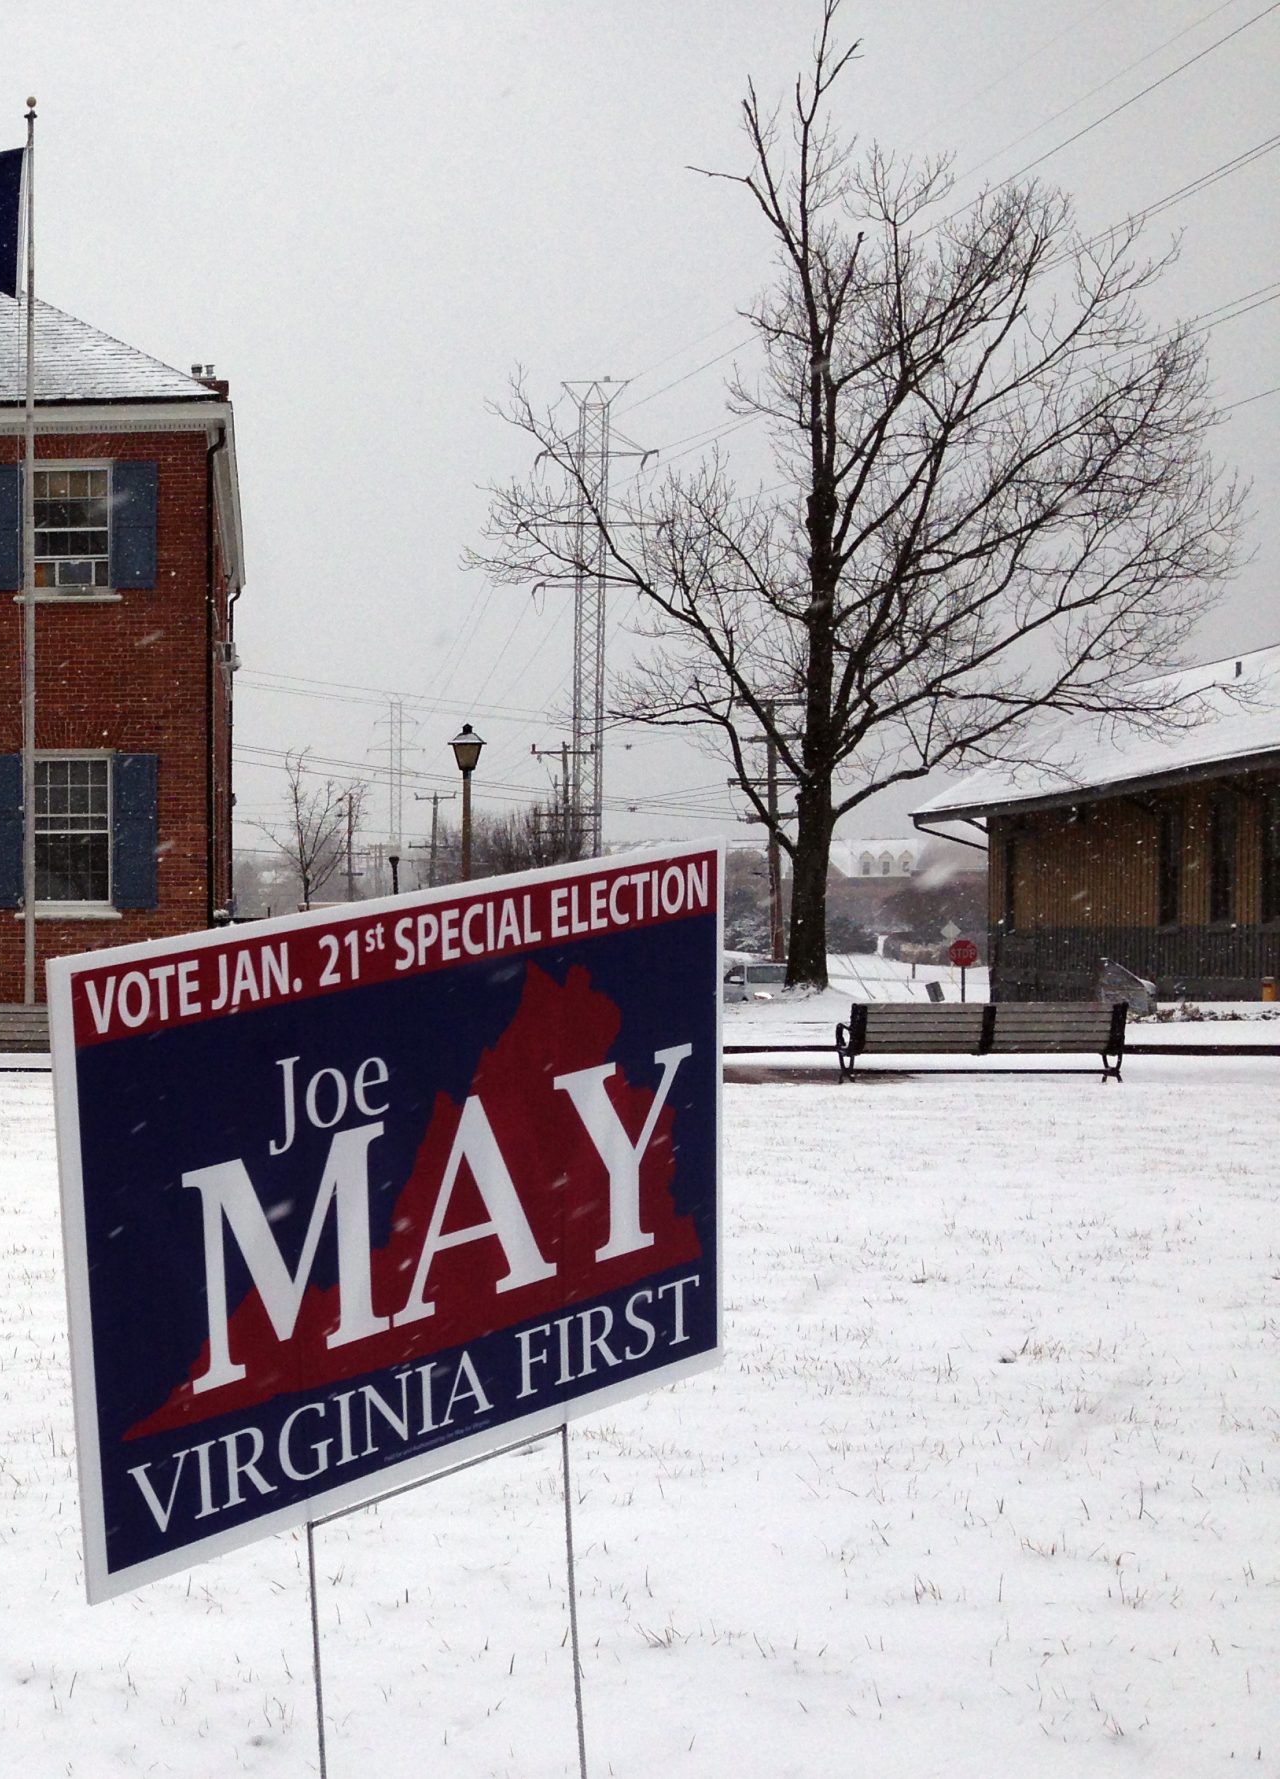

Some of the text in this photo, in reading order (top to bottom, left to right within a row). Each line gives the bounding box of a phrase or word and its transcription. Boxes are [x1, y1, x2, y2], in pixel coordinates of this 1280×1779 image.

[85, 860, 710, 1034] VOTE JAN. 21st SPECIAL ELECTION
[950, 948, 976, 958] STOP
[270, 1056, 391, 1156] Joe
[181, 1043, 693, 1395] MAY
[128, 1275, 700, 1534] VIRGINIA FIRST
